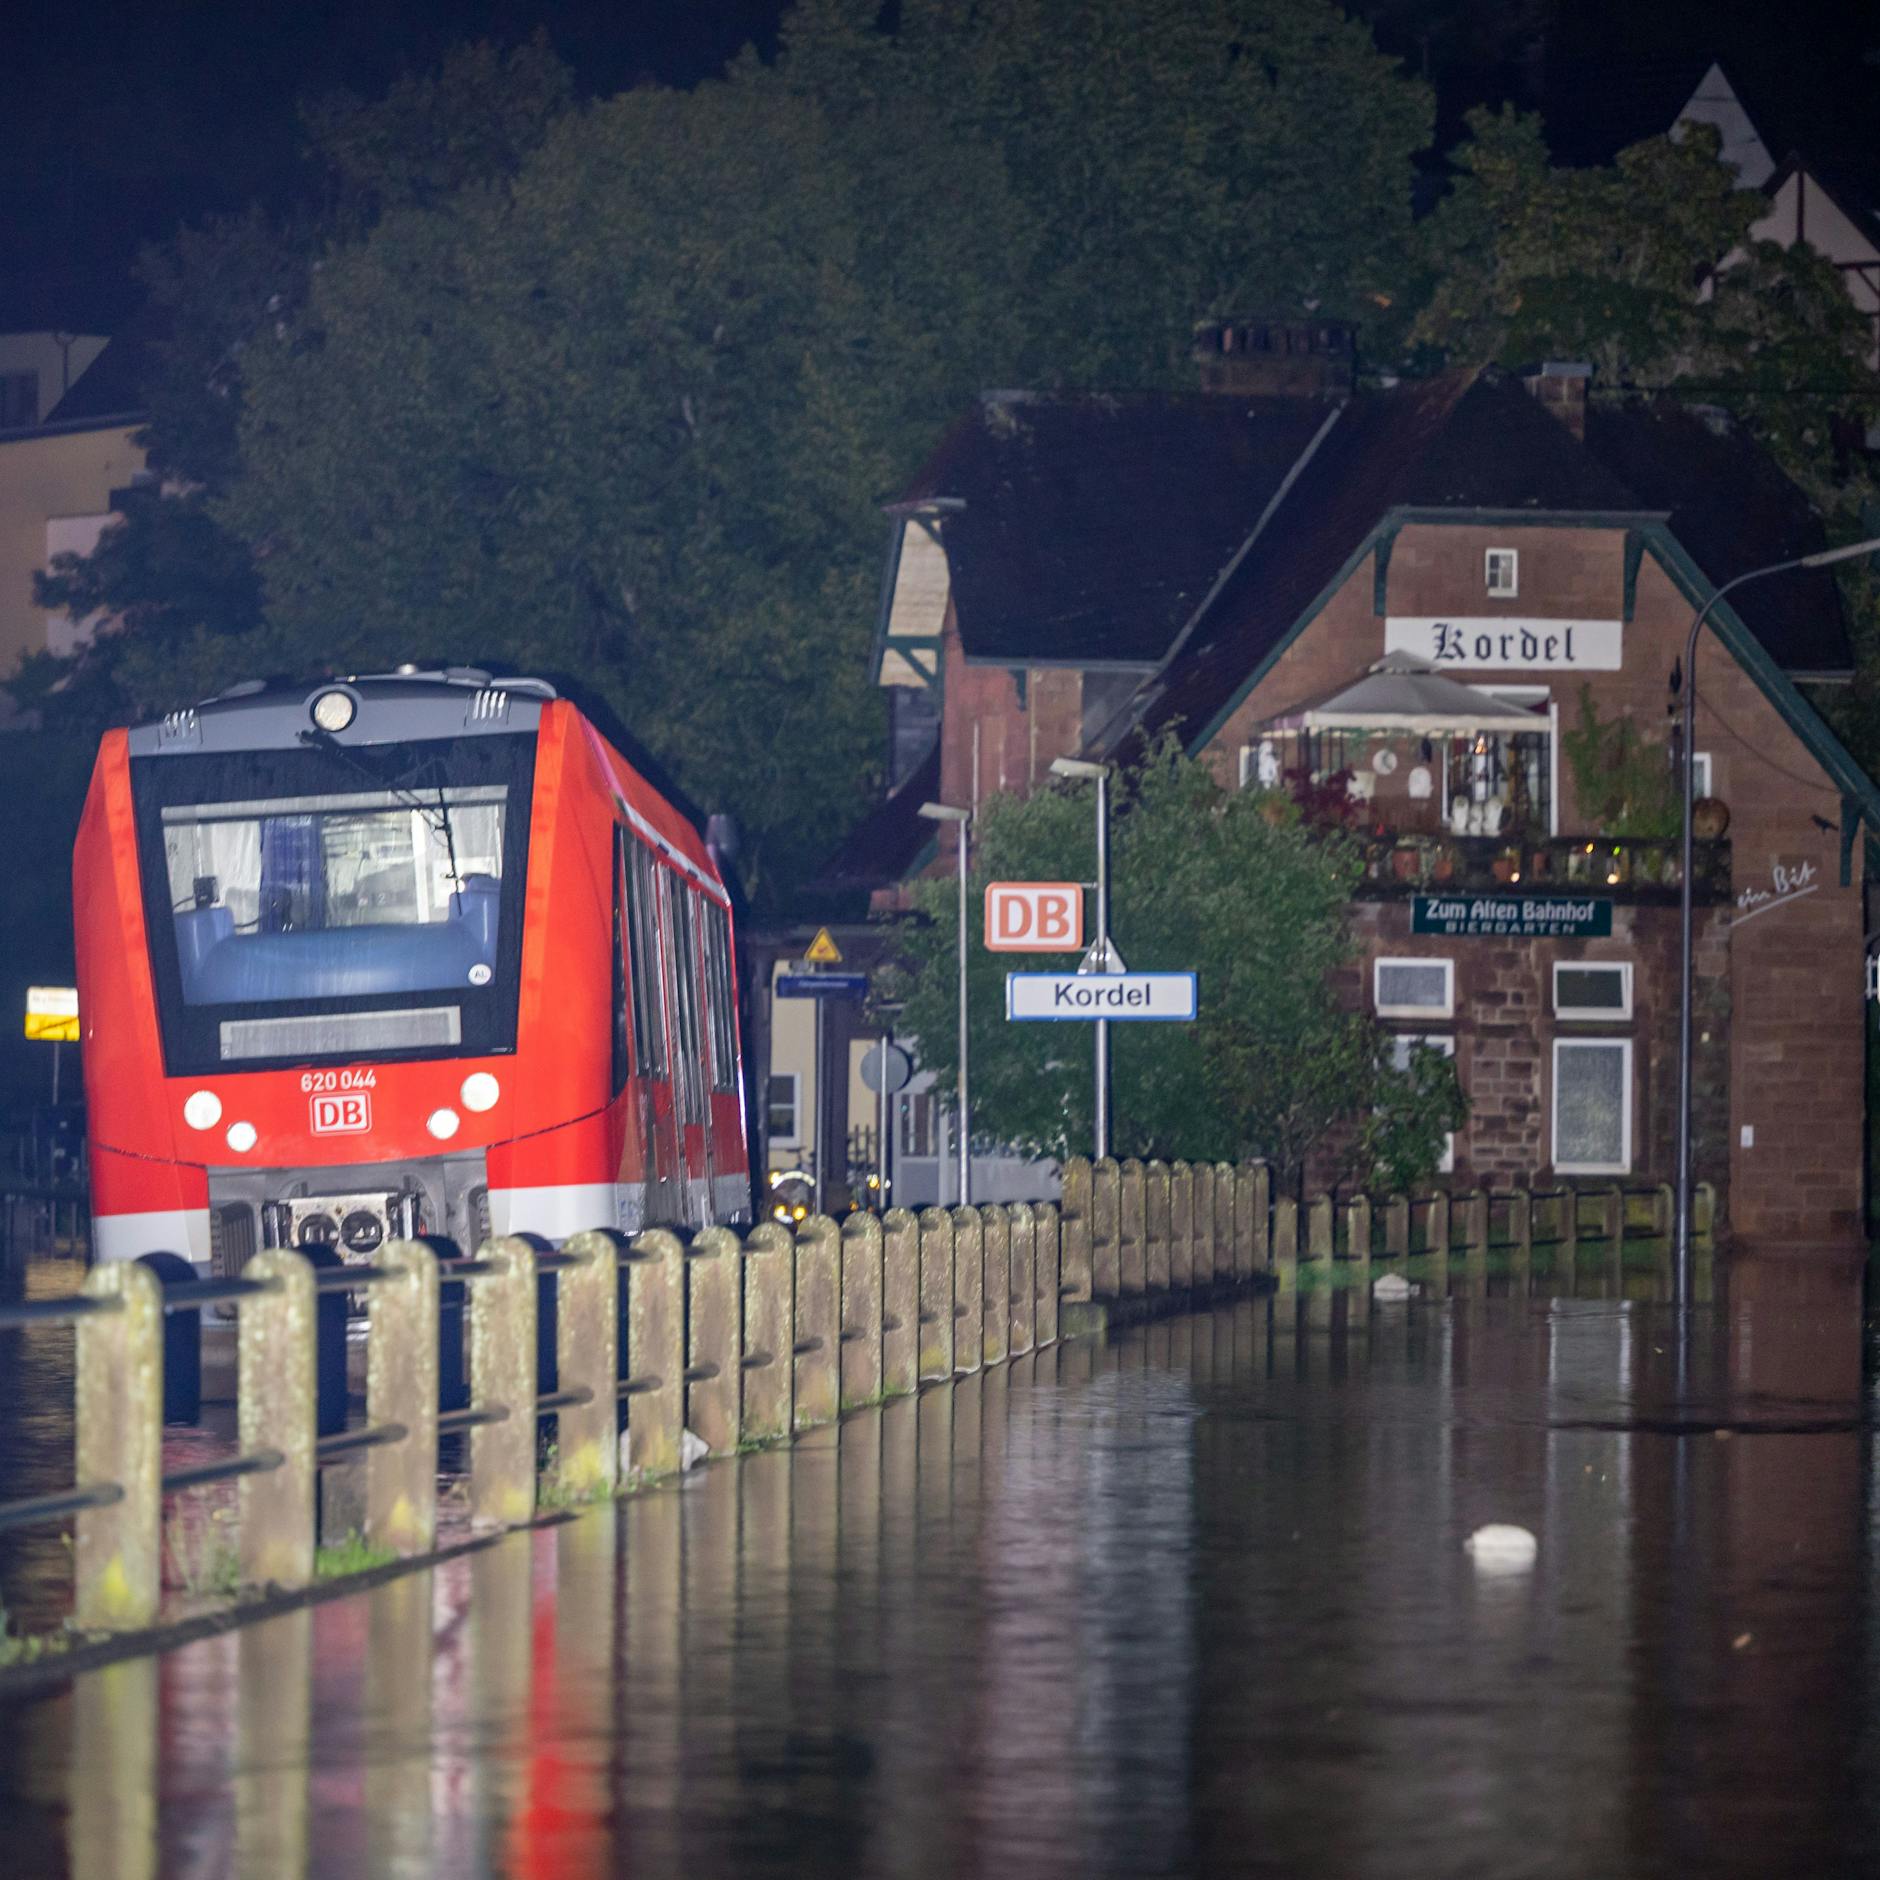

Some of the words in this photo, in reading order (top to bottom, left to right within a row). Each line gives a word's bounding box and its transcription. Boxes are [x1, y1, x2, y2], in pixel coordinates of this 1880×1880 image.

[1432, 623, 1575, 662] Kordel
[998, 894, 1070, 939] DB
[1426, 899, 1466, 919] Zum
[1470, 901, 1518, 920] Alten
[1522, 902, 1595, 922] Bahnhof
[1445, 921, 1576, 934] BIERGARTEN
[1054, 981, 1151, 1006] Kordel
[301, 1072, 337, 1092] 620
[340, 1069, 377, 1090] 044
[319, 1101, 362, 1127] DB
